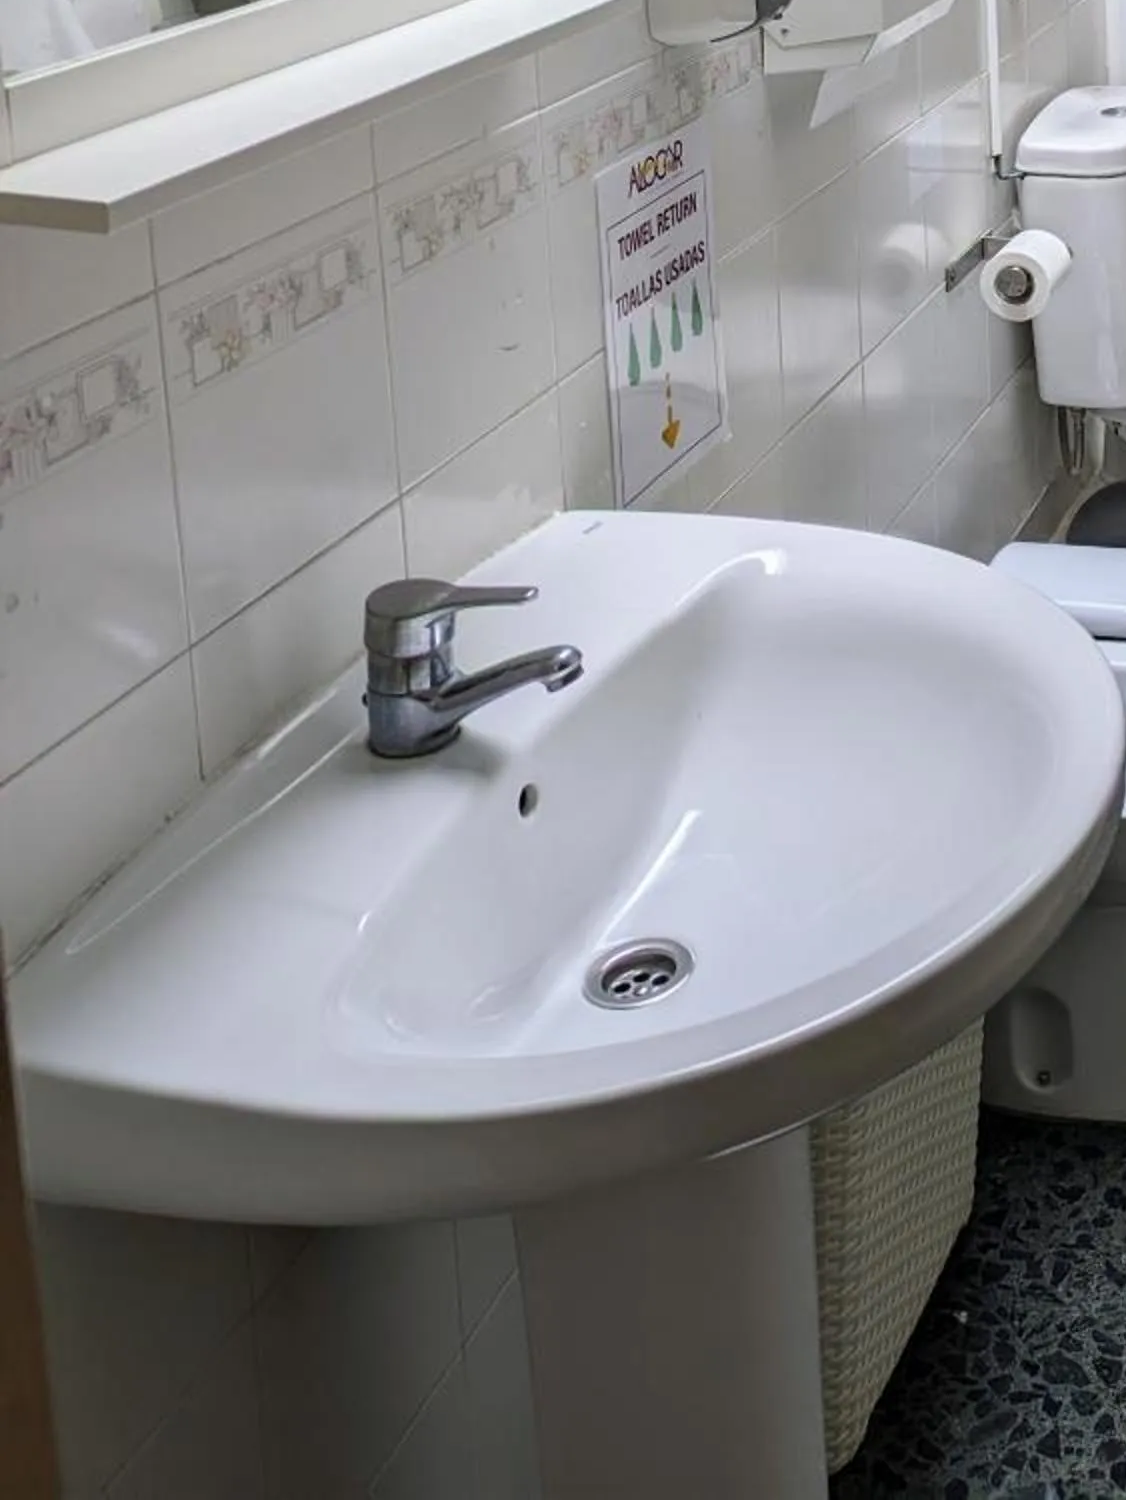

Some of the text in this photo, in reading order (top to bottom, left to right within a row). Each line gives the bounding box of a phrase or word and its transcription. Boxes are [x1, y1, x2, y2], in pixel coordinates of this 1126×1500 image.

[617, 191, 698, 261] TOWEL RETURN
[616, 240, 706, 321] TOALLAS USADAS
